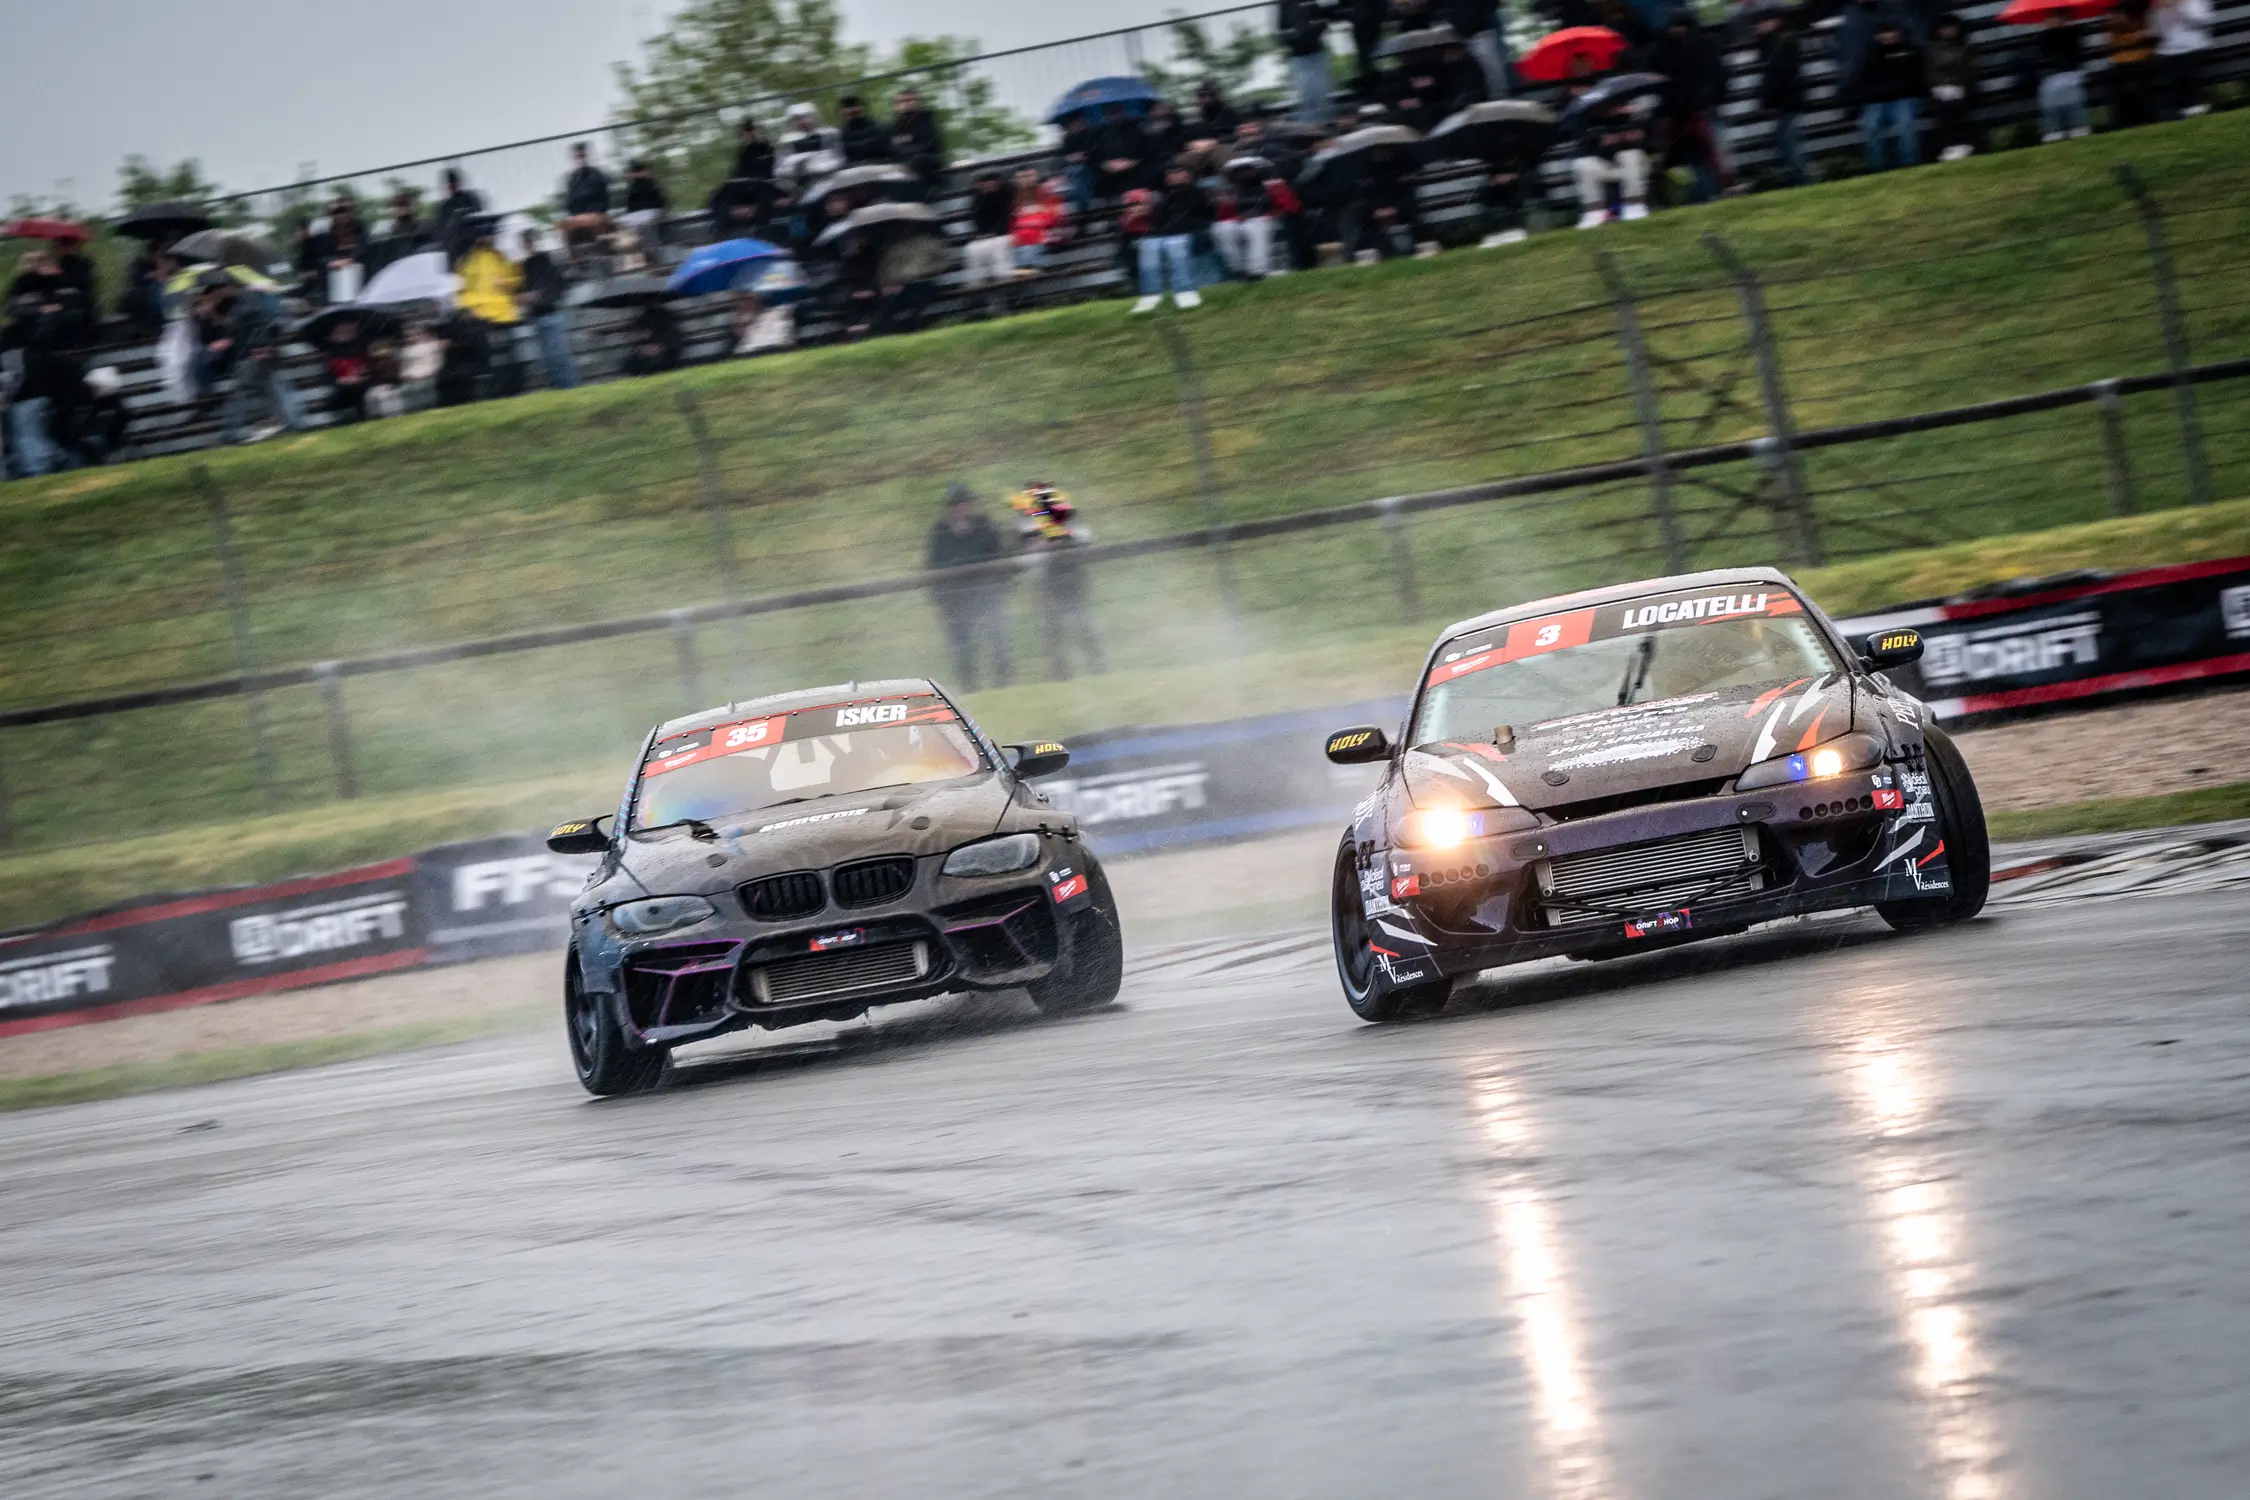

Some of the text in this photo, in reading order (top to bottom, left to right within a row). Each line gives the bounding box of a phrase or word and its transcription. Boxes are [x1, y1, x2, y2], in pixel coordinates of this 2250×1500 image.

[1622, 593, 1767, 630] LOCATELLI
[1534, 624, 1562, 647] 3
[1881, 634, 1918, 651] HOLY
[835, 704, 908, 728] ISKER
[726, 722, 769, 747] 35
[1328, 732, 1372, 753] HOLY
[1035, 743, 1063, 755] HOLY
